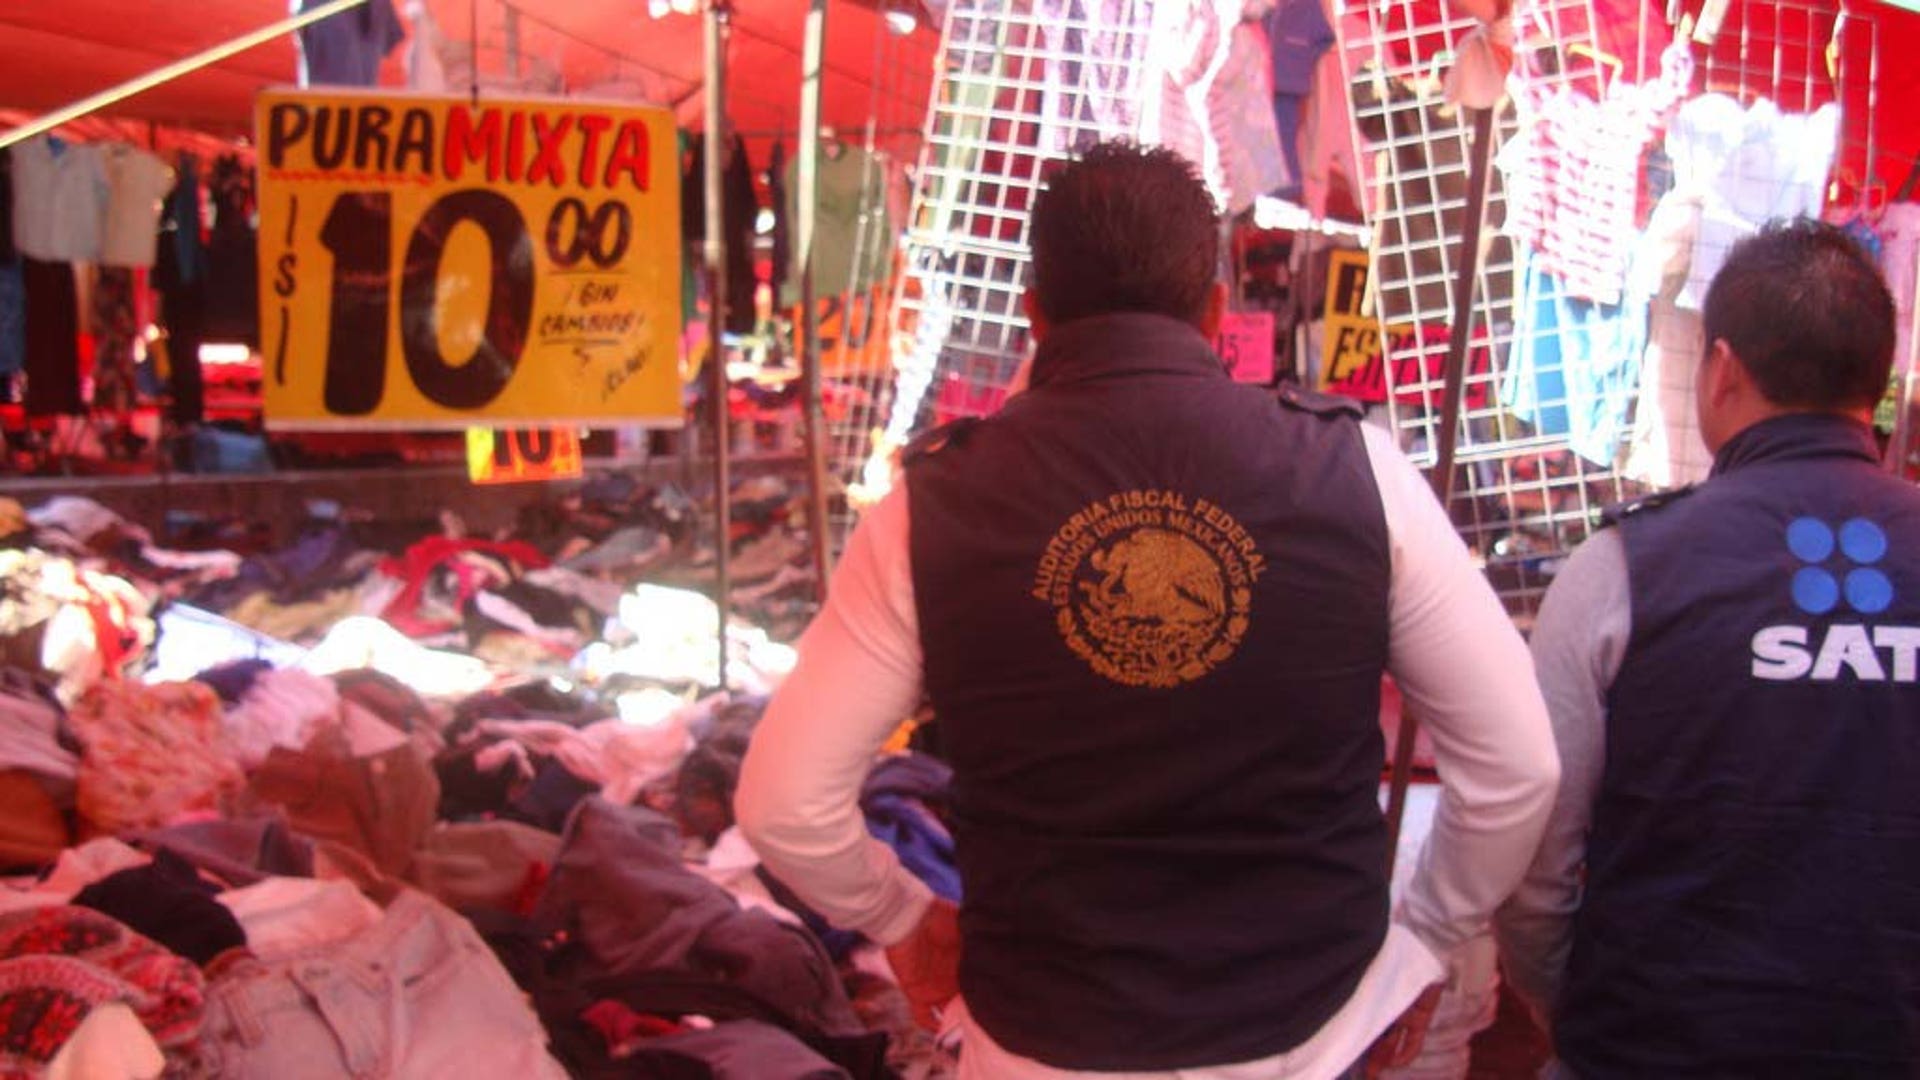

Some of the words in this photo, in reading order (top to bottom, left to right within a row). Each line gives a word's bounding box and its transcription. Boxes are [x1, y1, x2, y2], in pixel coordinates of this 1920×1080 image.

[268, 103, 435, 173] PURA
[442, 105, 650, 191] MIXTA
[319, 188, 536, 416] 10
[545, 196, 631, 270] 00
[1033, 502, 1109, 600] AUDITORIA
[1109, 489, 1186, 512] FISCAL
[1193, 498, 1266, 583] FEDERAL
[1052, 533, 1096, 606] ESTADOS
[1094, 511, 1162, 538] UNIDOS
[1752, 624, 1920, 682] SAT
